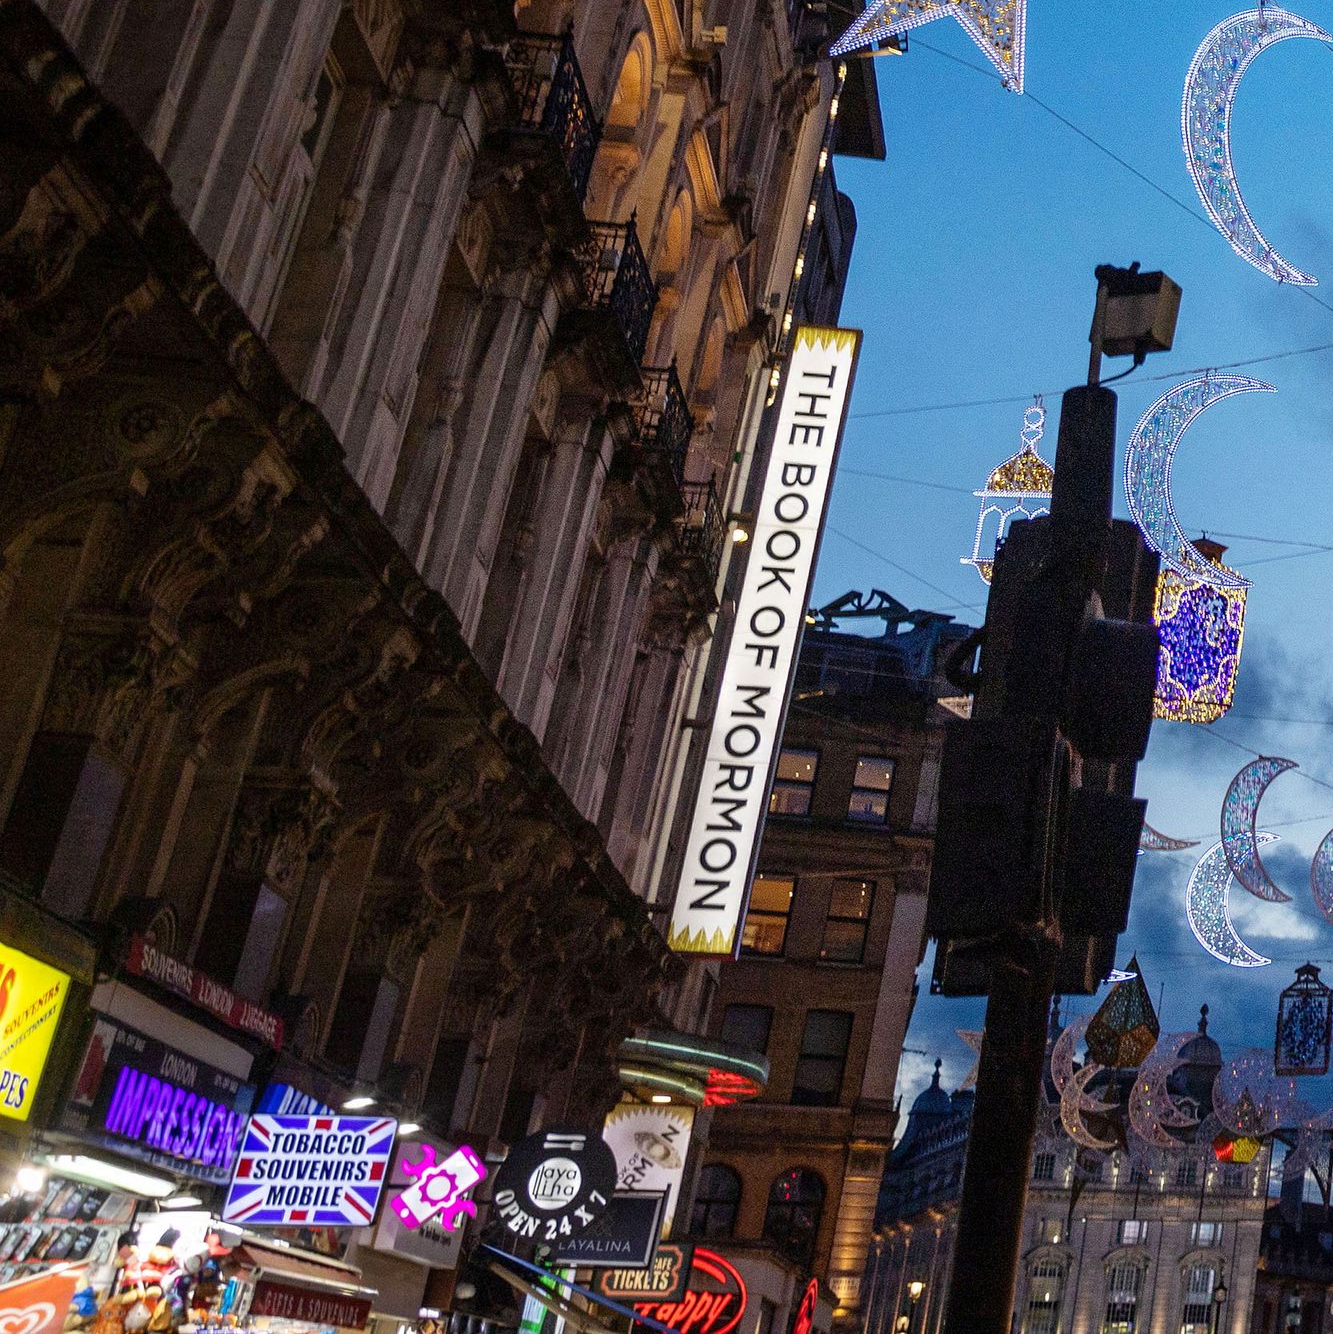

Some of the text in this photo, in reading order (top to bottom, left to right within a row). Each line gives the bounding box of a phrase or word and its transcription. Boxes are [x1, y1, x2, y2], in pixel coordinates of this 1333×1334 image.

[688, 364, 838, 913] THE BOOK OF MORMON
[141, 942, 194, 994] SOUVENIRS
[199, 977, 235, 1020] LONDON
[4, 981, 61, 1039] SOUVENIRS
[160, 1051, 198, 1087] LONDON
[0, 1070, 29, 1109] PES
[271, 1132, 367, 1156] TOBACCO
[253, 1158, 370, 1182] SOUVENIRS
[265, 1185, 344, 1208] MOBILE
[495, 1189, 541, 1238] OPEN
[545, 1215, 573, 1241] 24
[589, 1189, 607, 1206] 7
[558, 1238, 632, 1253] LAYALINA
[266, 1289, 295, 1311] GIFTS
[308, 1297, 361, 1325] SOUVENIRS
